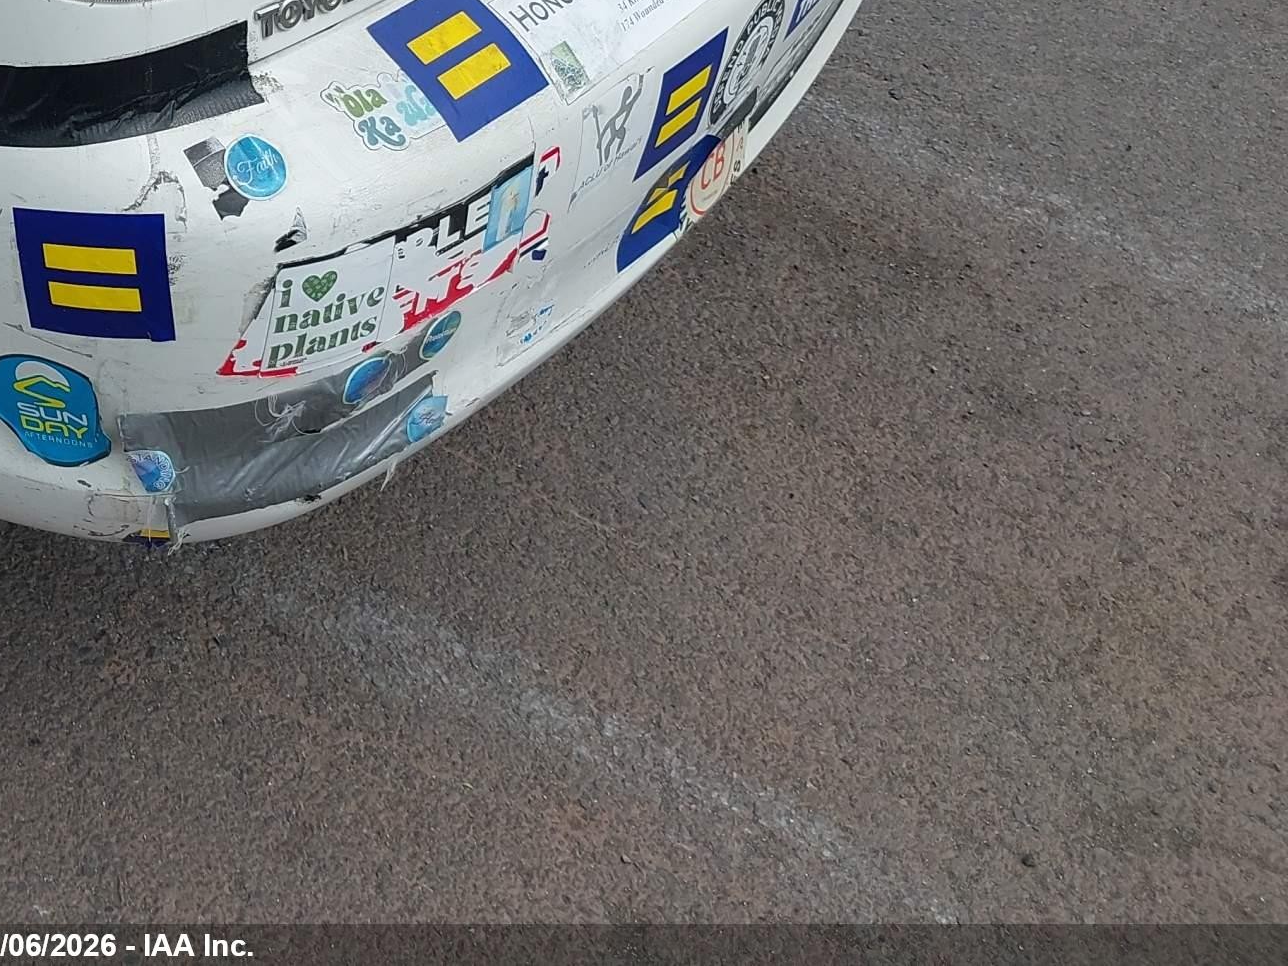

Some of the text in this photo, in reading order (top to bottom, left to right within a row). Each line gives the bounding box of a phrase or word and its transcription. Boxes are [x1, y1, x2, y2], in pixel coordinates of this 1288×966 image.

[358, 116, 406, 146] Ka
[234, 148, 278, 186] Faith
[278, 279, 294, 309] i
[273, 286, 385, 334] native
[267, 315, 378, 369] plants
[17, 401, 89, 427] SUN
[20, 415, 89, 440] DAY
[23, 432, 94, 449] AFTERNOONS
